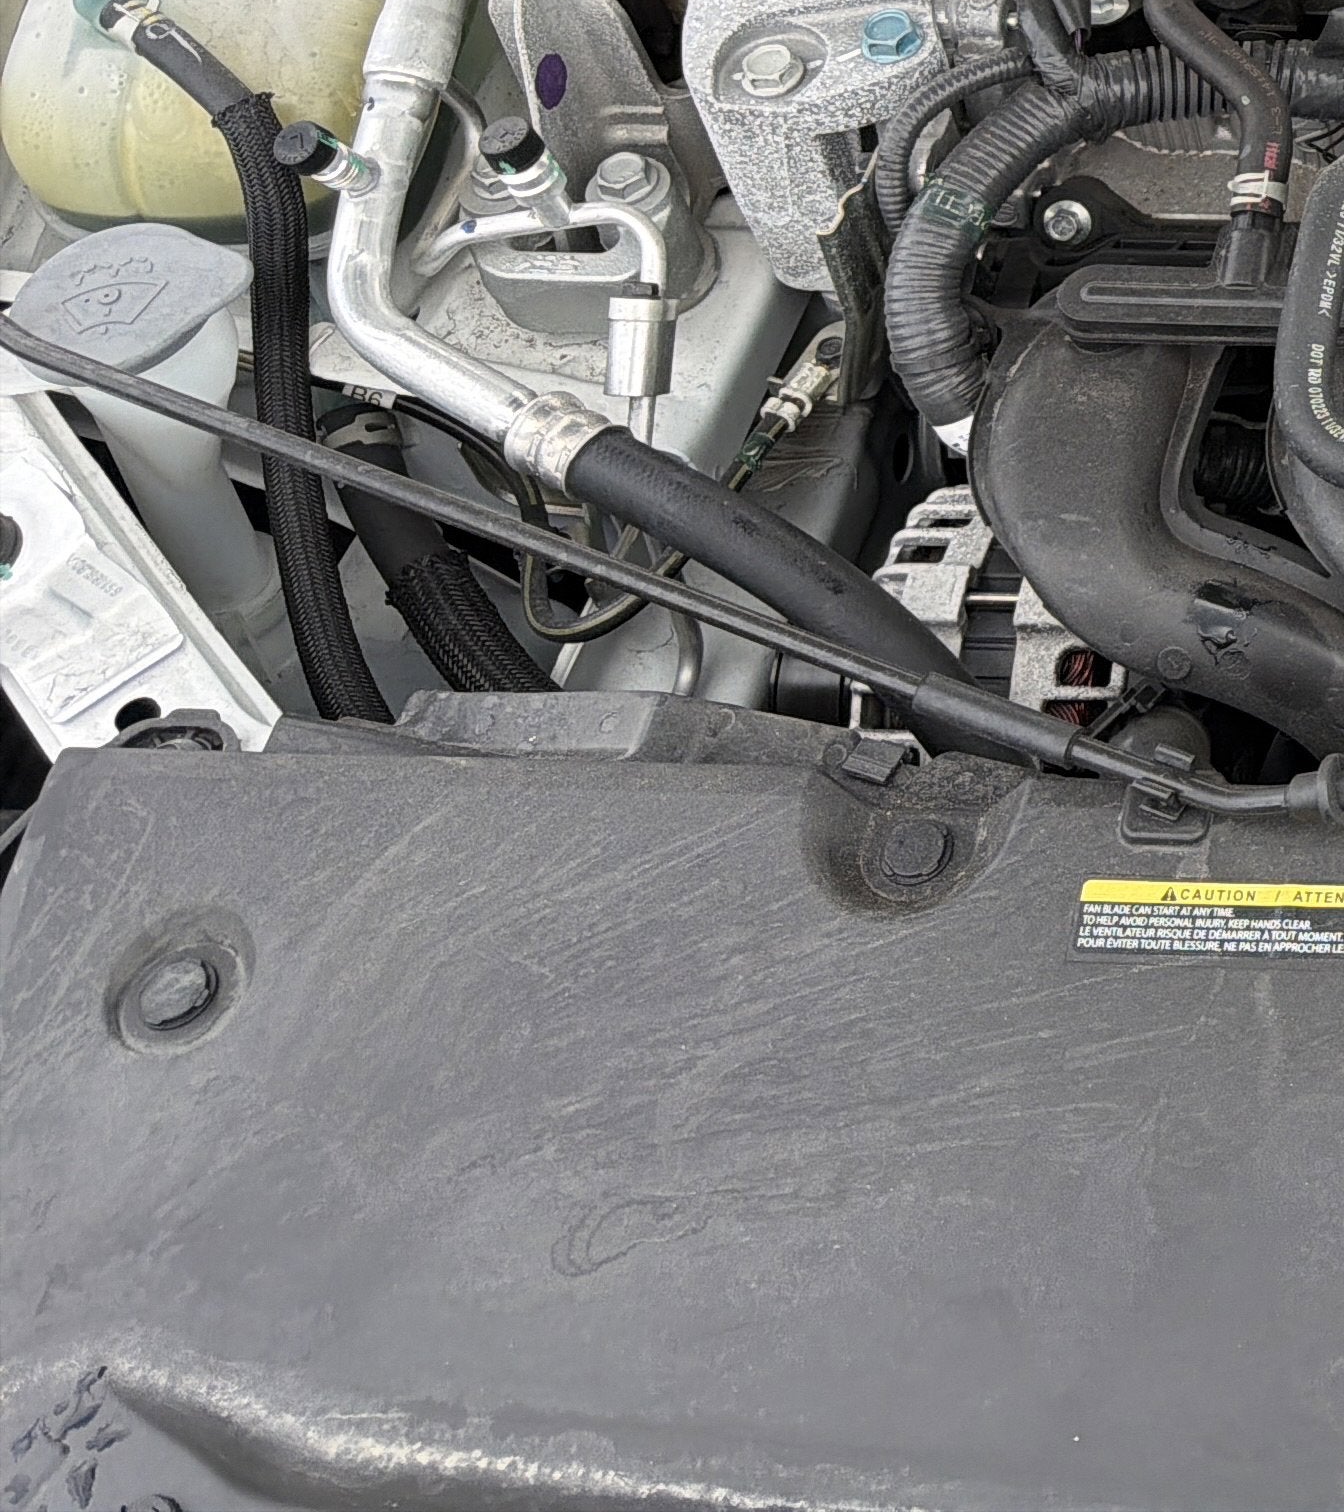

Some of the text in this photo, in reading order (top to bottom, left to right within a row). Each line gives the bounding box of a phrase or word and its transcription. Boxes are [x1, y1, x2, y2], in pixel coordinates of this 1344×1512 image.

[1181, 889, 1257, 902] CAUTION
[1274, 890, 1281, 902] /
[1083, 904, 1101, 914] FAN
[1103, 905, 1131, 915] BLADE
[1132, 906, 1151, 915] CAN
[1153, 906, 1179, 915] START
[1180, 907, 1192, 915] AT
[1083, 915, 1095, 925] TO
[1096, 916, 1118, 926] HELP
[1119, 917, 1147, 926] AVOID
[1148, 918, 1194, 928] PERSONAL
[1229, 919, 1251, 929] KEEP
[1252, 920, 1281, 929] HANDS
[1282, 920, 1312, 930] CLEAR.
[1080, 926, 1091, 936] LE
[1093, 927, 1155, 938] VENTILATEUR
[1156, 929, 1192, 939] RISQUE
[1193, 930, 1207, 938] DE
[1209, 928, 1264, 940] DÉMARRER
[1272, 931, 1296, 940] TOUT
[1298, 931, 1344, 942] MOMENT.
[1077, 938, 1105, 948] POUR
[1106, 936, 1138, 949] ÉVITER
[1140, 939, 1171, 949] TOUTE
[1173, 940, 1222, 952] BLESSURE,
[1224, 942, 1238, 951] NE
[1239, 942, 1256, 952] PAS
[1258, 942, 1271, 952] EN
[1273, 943, 1331, 954] APPROCHER
